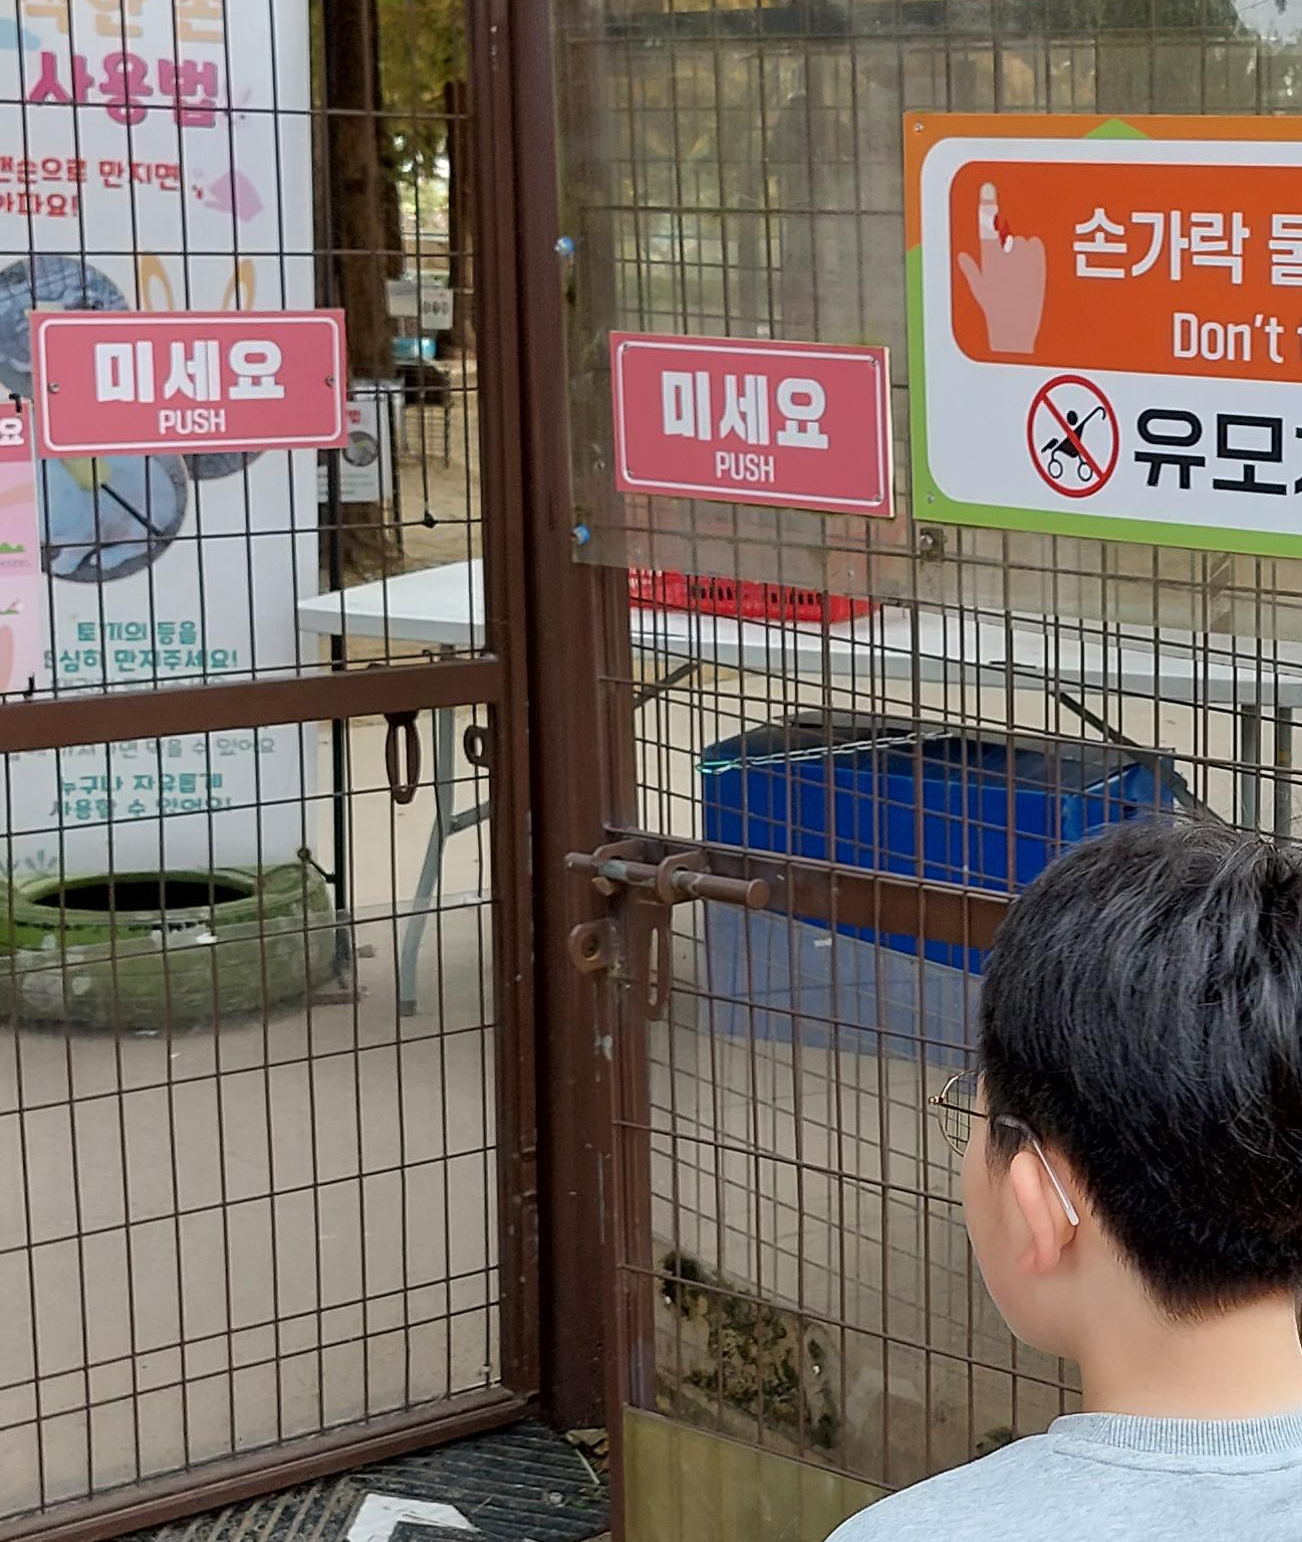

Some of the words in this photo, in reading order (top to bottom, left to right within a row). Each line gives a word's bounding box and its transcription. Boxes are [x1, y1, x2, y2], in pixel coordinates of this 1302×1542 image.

[29, 51, 219, 128] 사용법
[98, 159, 181, 193] 만지면
[1071, 207, 1250, 284] 손가락
[1173, 311, 1285, 364] Don't
[93, 339, 285, 404] 미세요
[158, 407, 227, 436] PUSH
[661, 370, 830, 451] 미세요
[714, 451, 777, 485] PUSH
